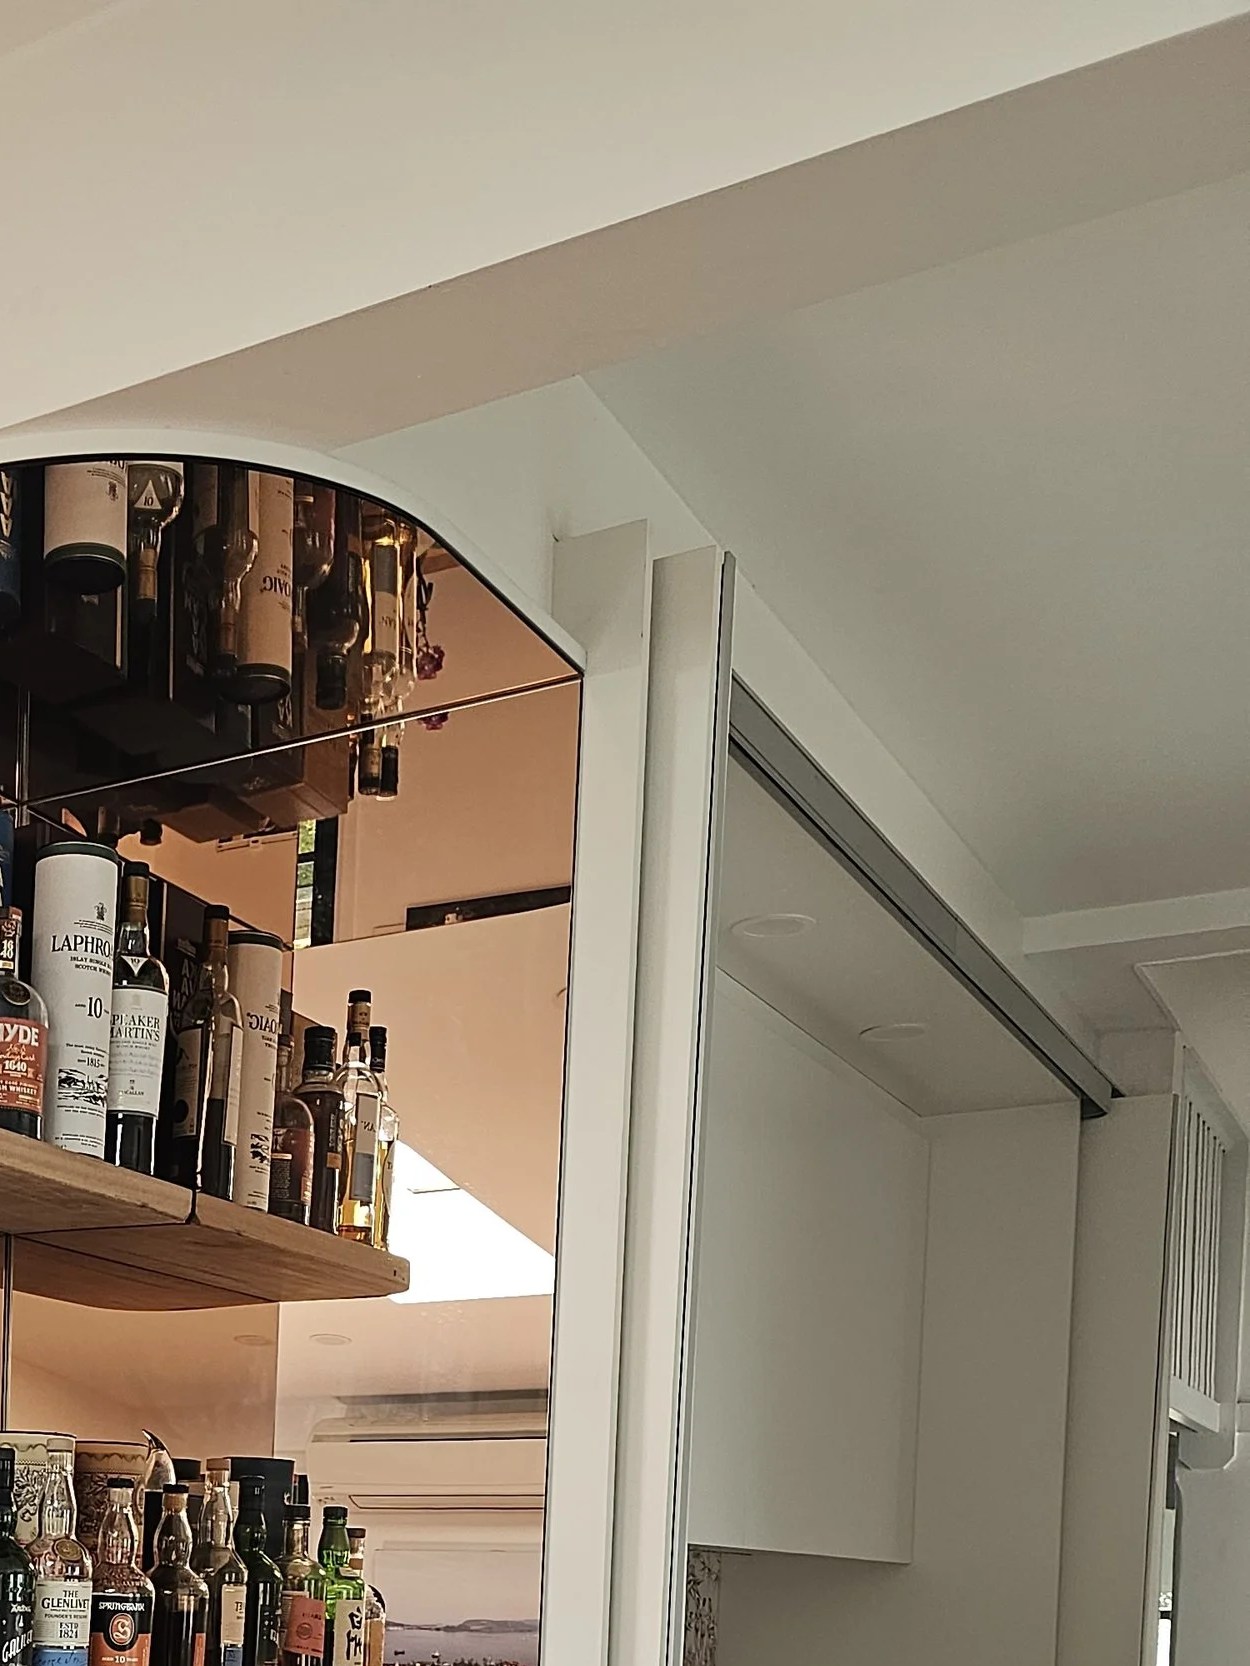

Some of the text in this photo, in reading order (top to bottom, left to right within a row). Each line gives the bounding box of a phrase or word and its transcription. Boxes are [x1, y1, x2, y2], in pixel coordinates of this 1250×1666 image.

[87, 996, 103, 1018] 10
[63, 1590, 79, 1598] THE
[114, 1655, 126, 1664] 10
